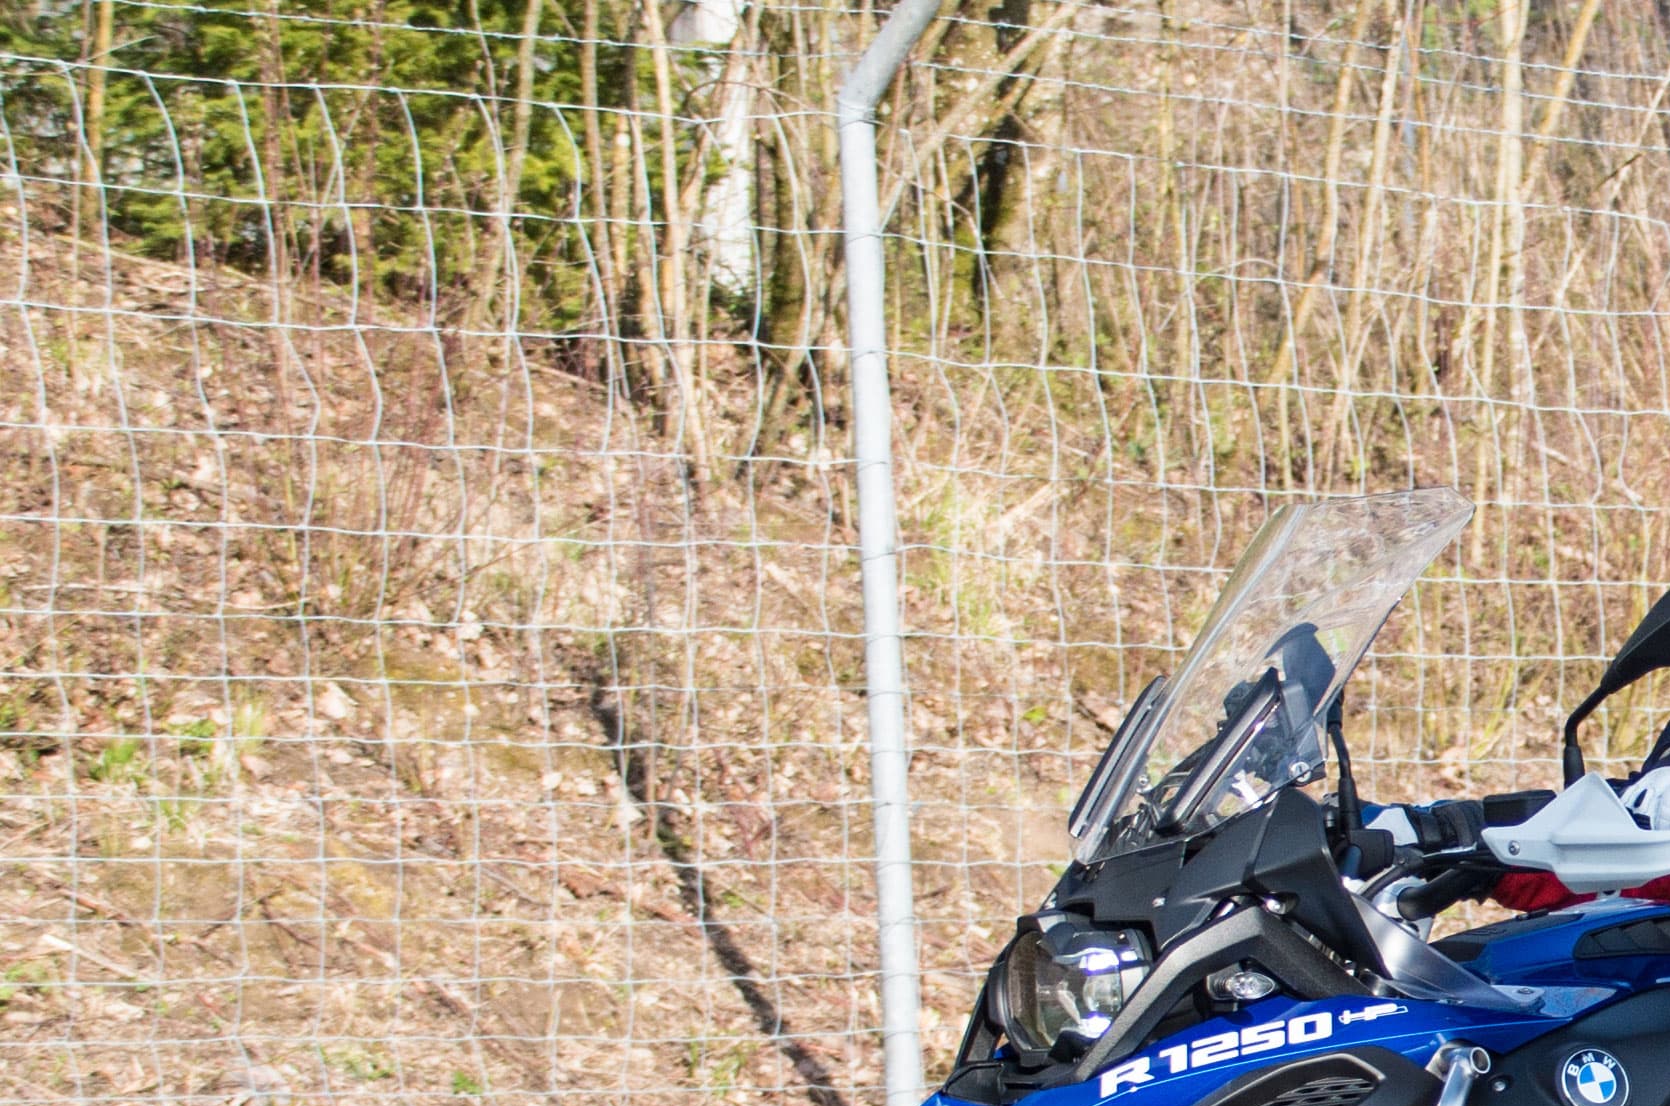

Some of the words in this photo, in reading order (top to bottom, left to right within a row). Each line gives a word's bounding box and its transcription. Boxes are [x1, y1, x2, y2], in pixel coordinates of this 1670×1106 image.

[1100, 1056, 1155, 1099] R
[1159, 1011, 1333, 1074] 1250
[1567, 1052, 1617, 1077] BMW
